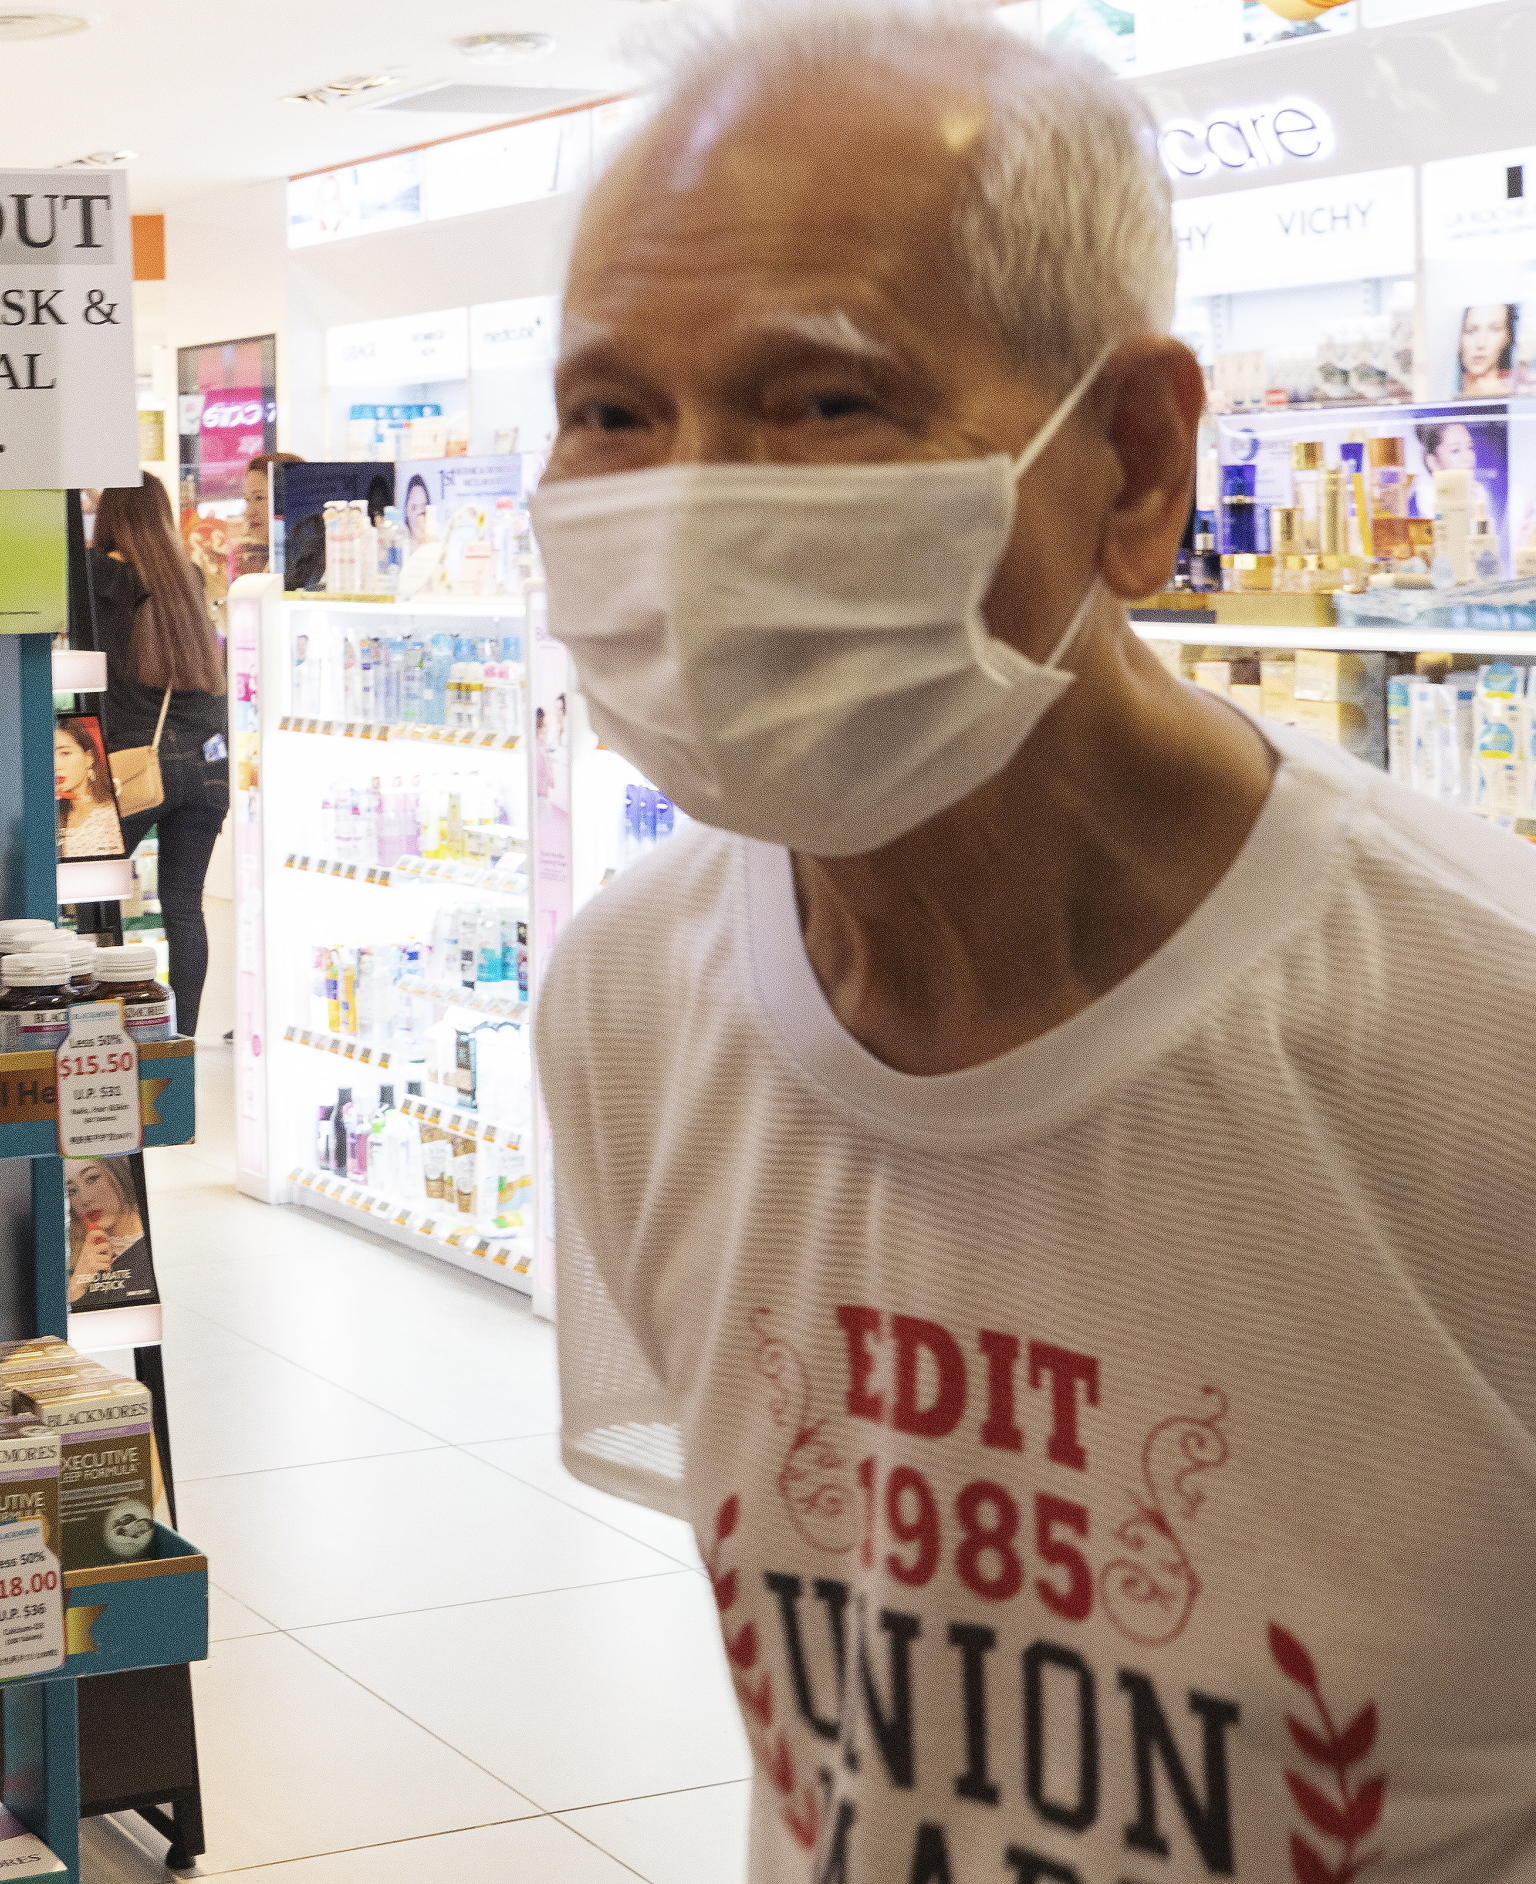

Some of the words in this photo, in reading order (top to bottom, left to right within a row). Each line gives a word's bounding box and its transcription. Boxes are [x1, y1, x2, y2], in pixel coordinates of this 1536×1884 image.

[1162, 107, 1322, 177] care
[1277, 198, 1375, 236] VICHY
[83, 289, 121, 327] &
[59, 1051, 135, 1081] $15.50
[72, 1087, 98, 1101] U.P.
[836, 1304, 1102, 1474] EDIT
[47, 1402, 149, 1428] BLACKMORES
[83, 1463, 140, 1481] FORMULA
[858, 1453, 1096, 1624] 1985
[763, 1570, 1242, 1878] UNION
